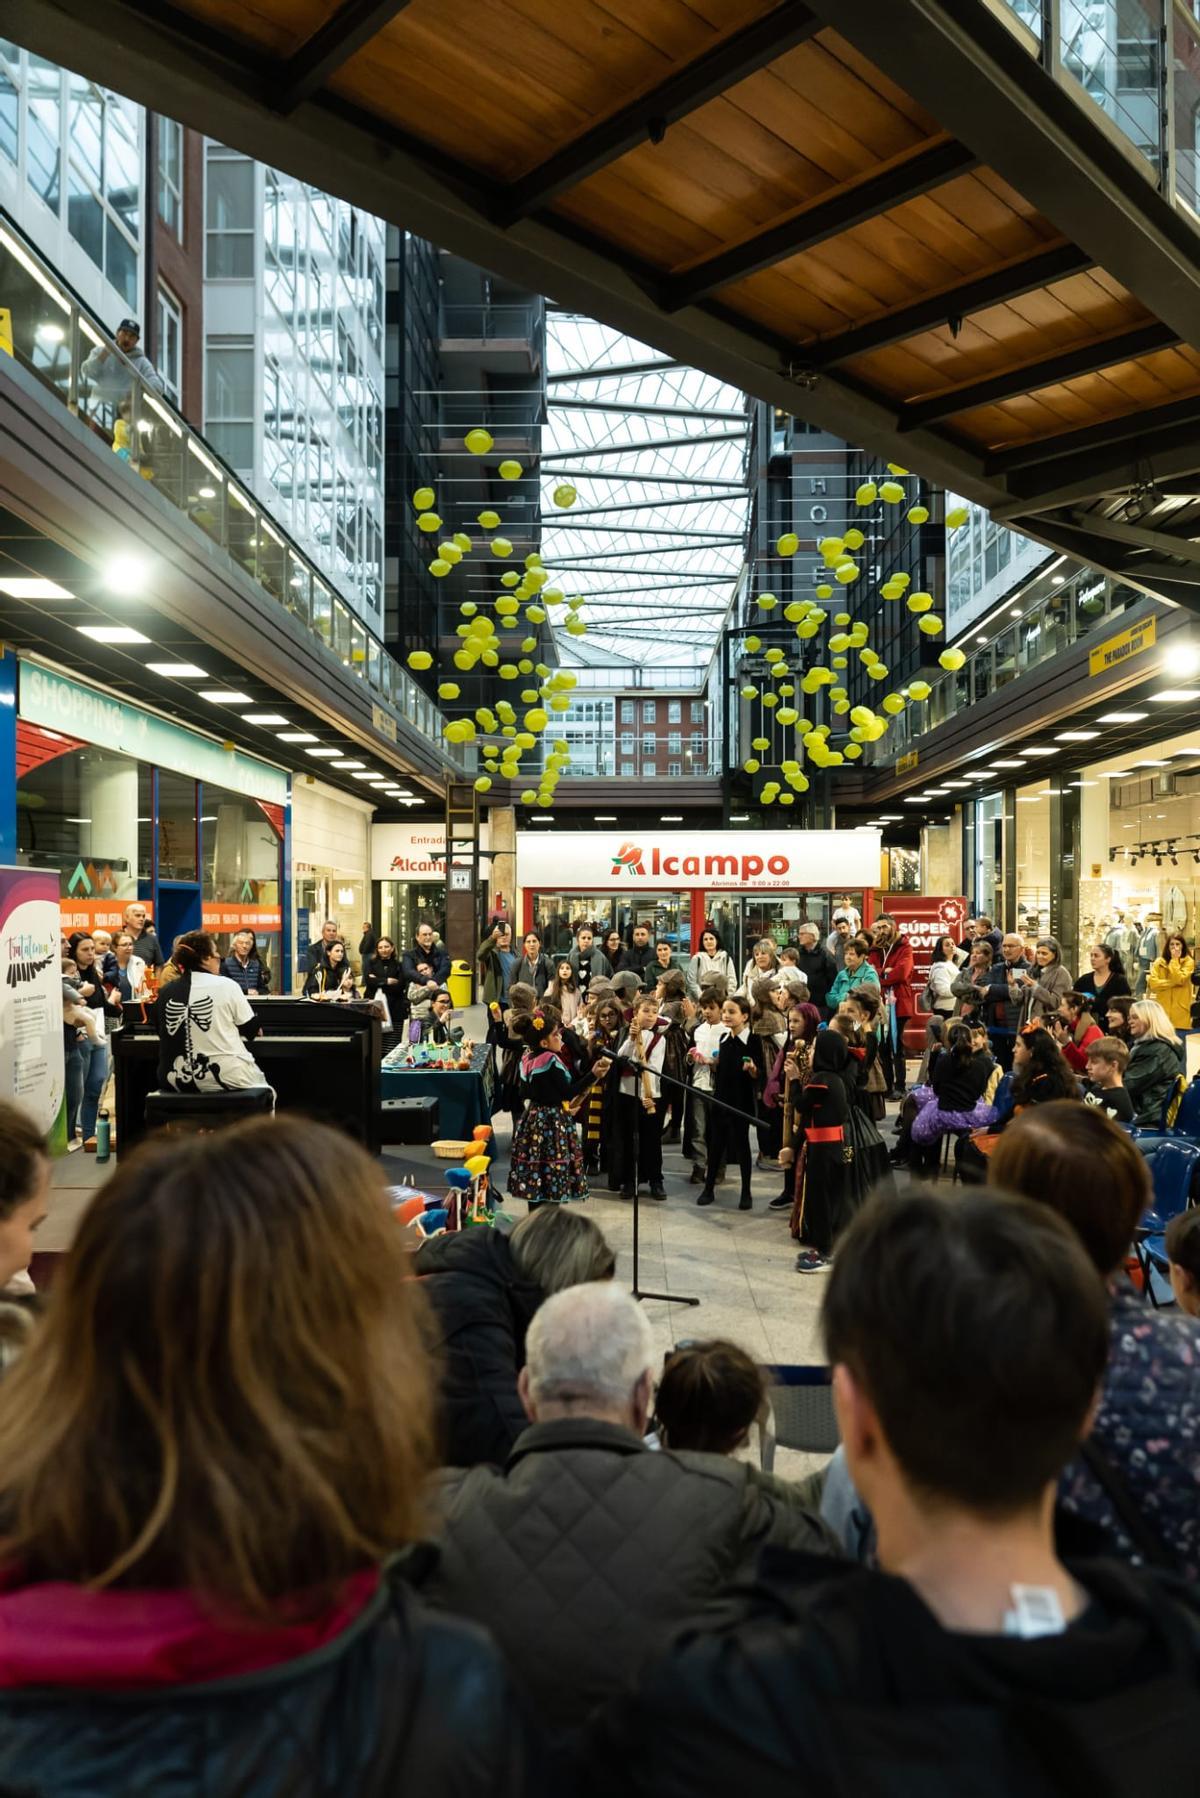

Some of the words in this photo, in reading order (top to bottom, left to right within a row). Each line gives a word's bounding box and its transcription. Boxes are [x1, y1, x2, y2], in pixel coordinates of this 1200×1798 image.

[30, 671, 124, 737] SHOPPING
[390, 856, 462, 874] Alcam
[611, 841, 790, 881] Alcampo
[899, 920, 950, 934] SÚPER
